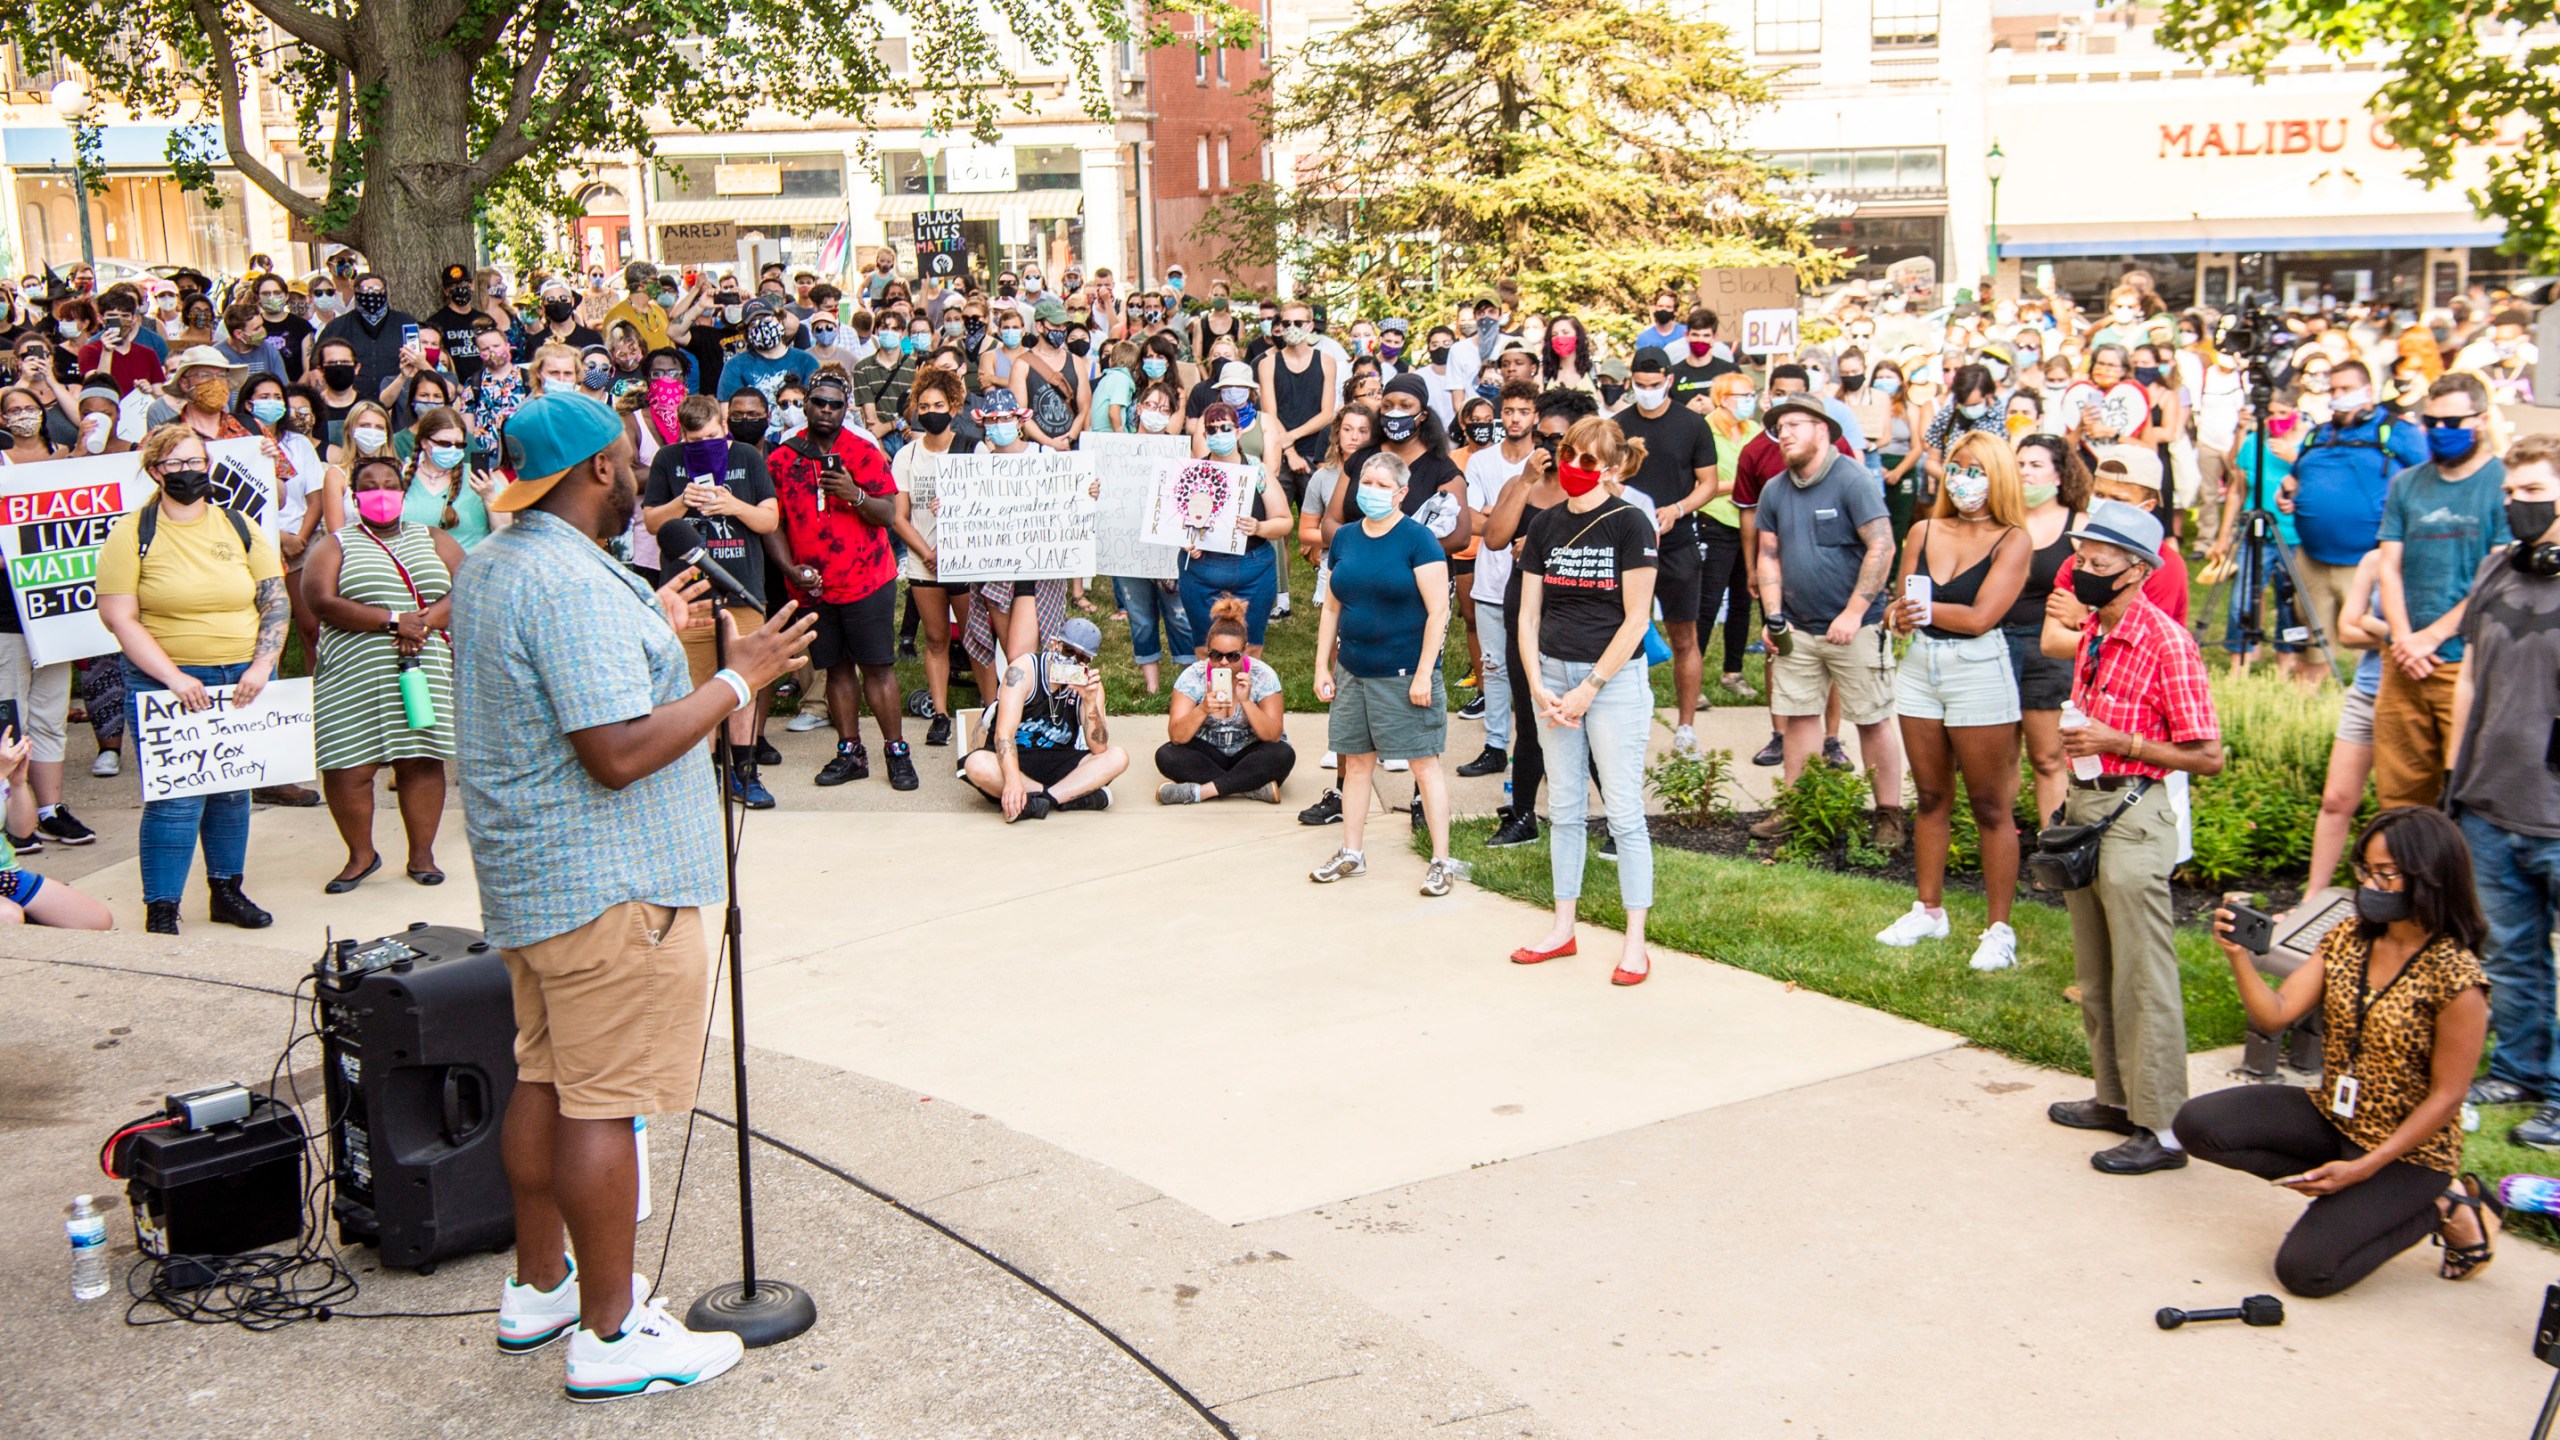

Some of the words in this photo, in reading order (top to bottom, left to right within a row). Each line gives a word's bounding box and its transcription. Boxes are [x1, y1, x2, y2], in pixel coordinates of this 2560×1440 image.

[2158, 119, 2348, 158] MALIBU
[953, 167, 1010, 180] LOLA
[917, 209, 962, 225] BLACK
[664, 223, 731, 238] ARREST
[917, 224, 960, 240] LIVES
[916, 237, 966, 253] MATTER
[1717, 270, 1782, 294] Black
[1748, 320, 1794, 347] BLM
[225, 455, 270, 494] solidarity
[998, 479, 1030, 498] LIVES
[8, 486, 112, 524] BLACK
[937, 503, 966, 519] are
[966, 500, 994, 518] the
[998, 498, 1059, 522] equivalent
[1063, 495, 1086, 514] of
[1152, 471, 1167, 535] BLACK
[1230, 475, 1249, 552] MATTER
[940, 521, 960, 535] THE
[963, 519, 1016, 532] FOUNDING
[1016, 513, 1063, 531] FATHERS
[967, 534, 993, 549] MEN
[995, 535, 1012, 546] ARE
[1015, 528, 1057, 545] CREATED
[978, 555, 1023, 575] owning
[1025, 546, 1082, 570] SLAVES
[1582, 546, 1599, 557] for
[1599, 547, 1614, 558] all
[1582, 557, 1598, 567] for
[1597, 558, 1614, 568] all
[1556, 566, 1580, 577] Jobs
[1580, 567, 1597, 577] for
[1597, 568, 1615, 578] all
[1578, 577, 1597, 588] for
[1597, 578, 1619, 589] all.
[146, 726, 200, 746] Ian
[207, 717, 266, 737] James
[152, 748, 208, 773] Jerry
[213, 742, 245, 761] Cox
[155, 770, 216, 796] Sean
